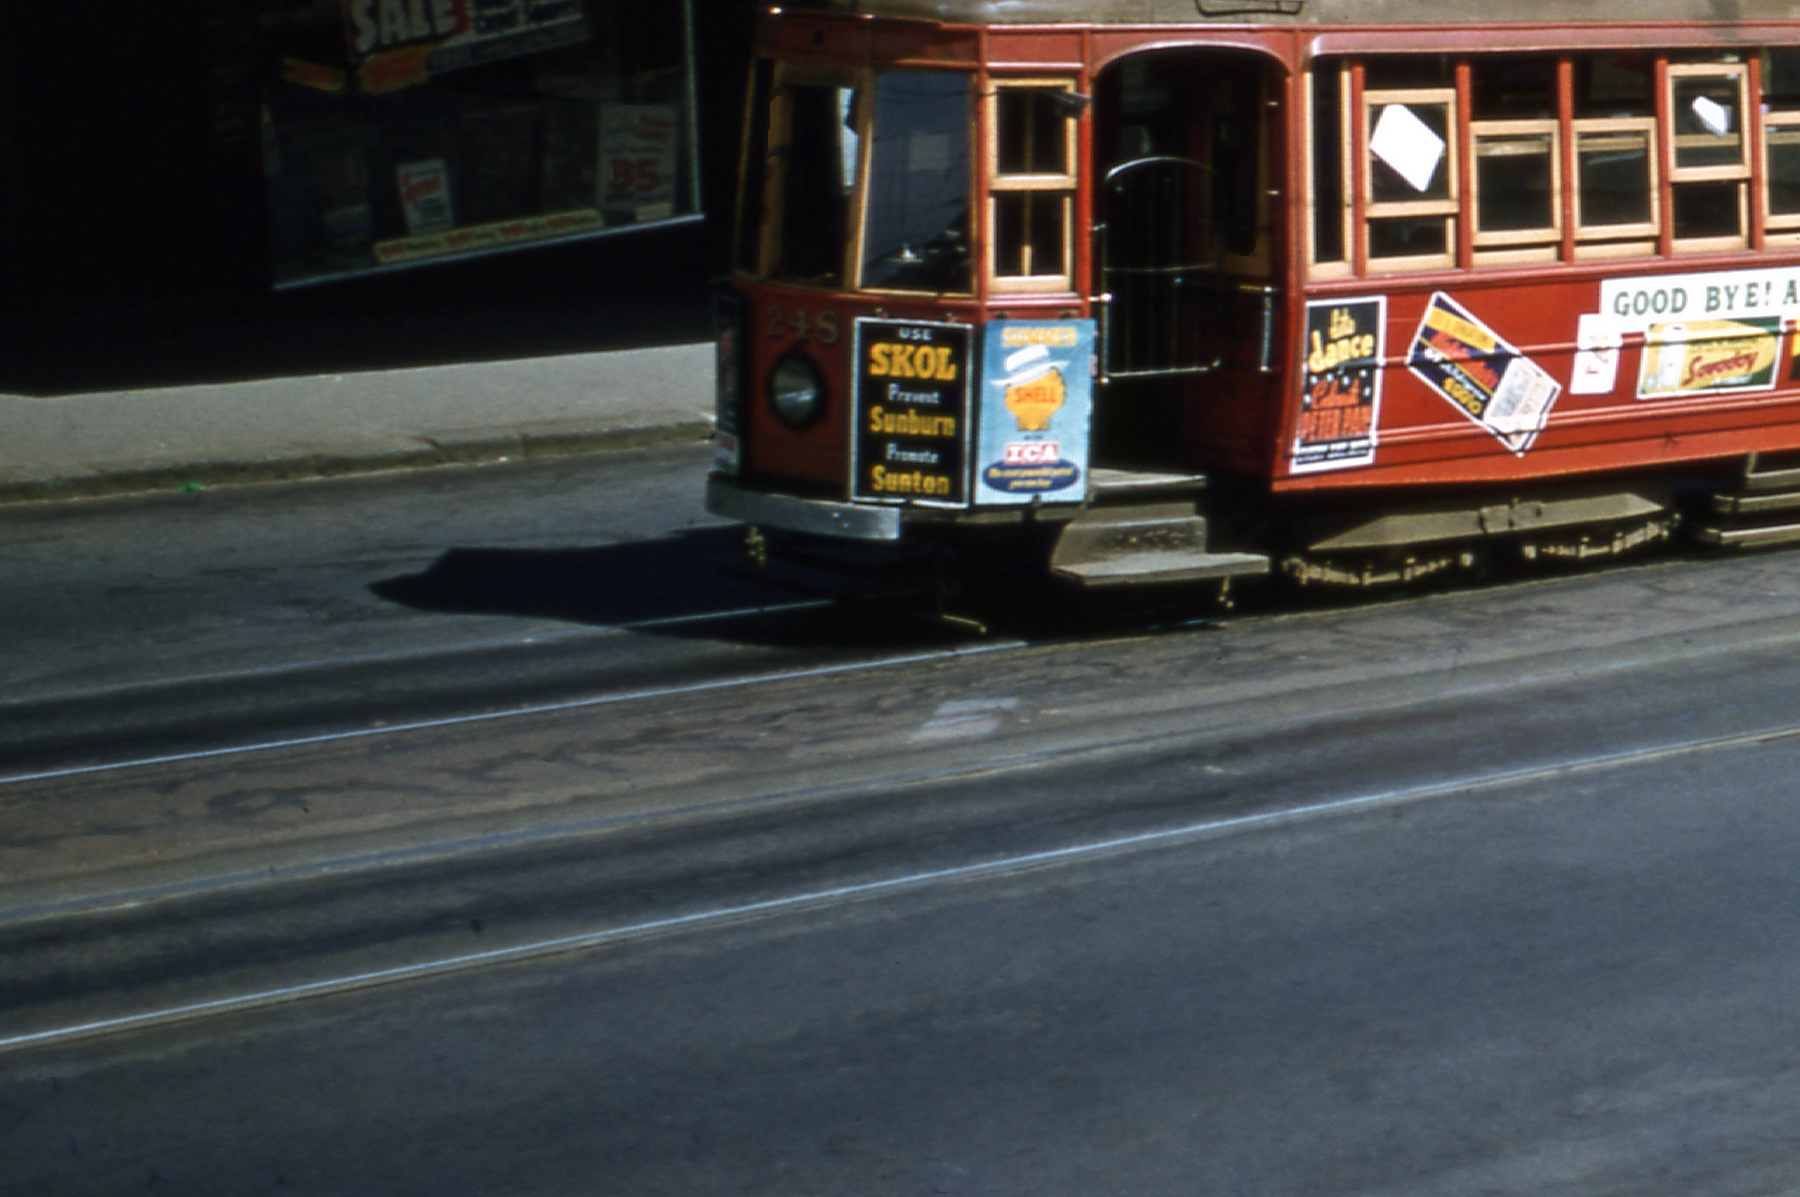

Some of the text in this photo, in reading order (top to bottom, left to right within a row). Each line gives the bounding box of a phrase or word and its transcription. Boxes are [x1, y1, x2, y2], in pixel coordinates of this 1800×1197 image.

[1614, 287, 1688, 316] GOOD
[1705, 281, 1771, 313] BYE!
[765, 306, 840, 346] 248
[899, 327, 932, 342] USE
[868, 341, 957, 382] SKOL
[1013, 383, 1058, 406] SHELL
[869, 407, 956, 438] Sunburn
[1004, 443, 1059, 464] ICA
